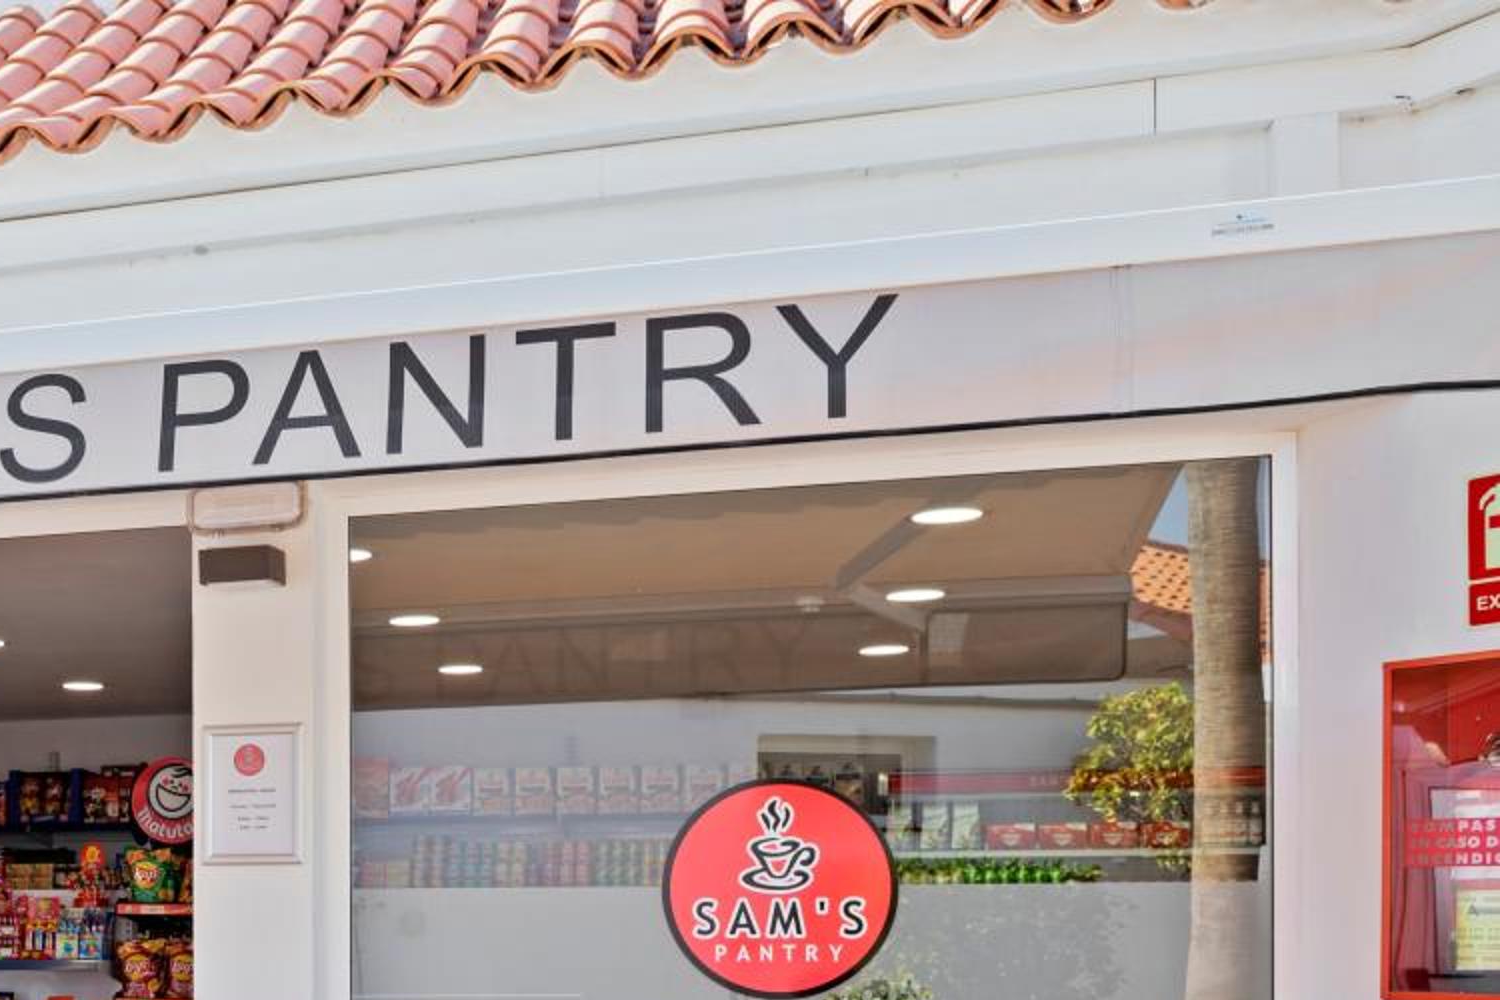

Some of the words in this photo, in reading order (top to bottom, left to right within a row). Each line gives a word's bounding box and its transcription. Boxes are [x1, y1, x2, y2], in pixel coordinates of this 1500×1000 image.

[157, 293, 899, 472] PANTRY
[692, 896, 867, 939] SAM'S
[713, 943, 846, 962] PANTRY
